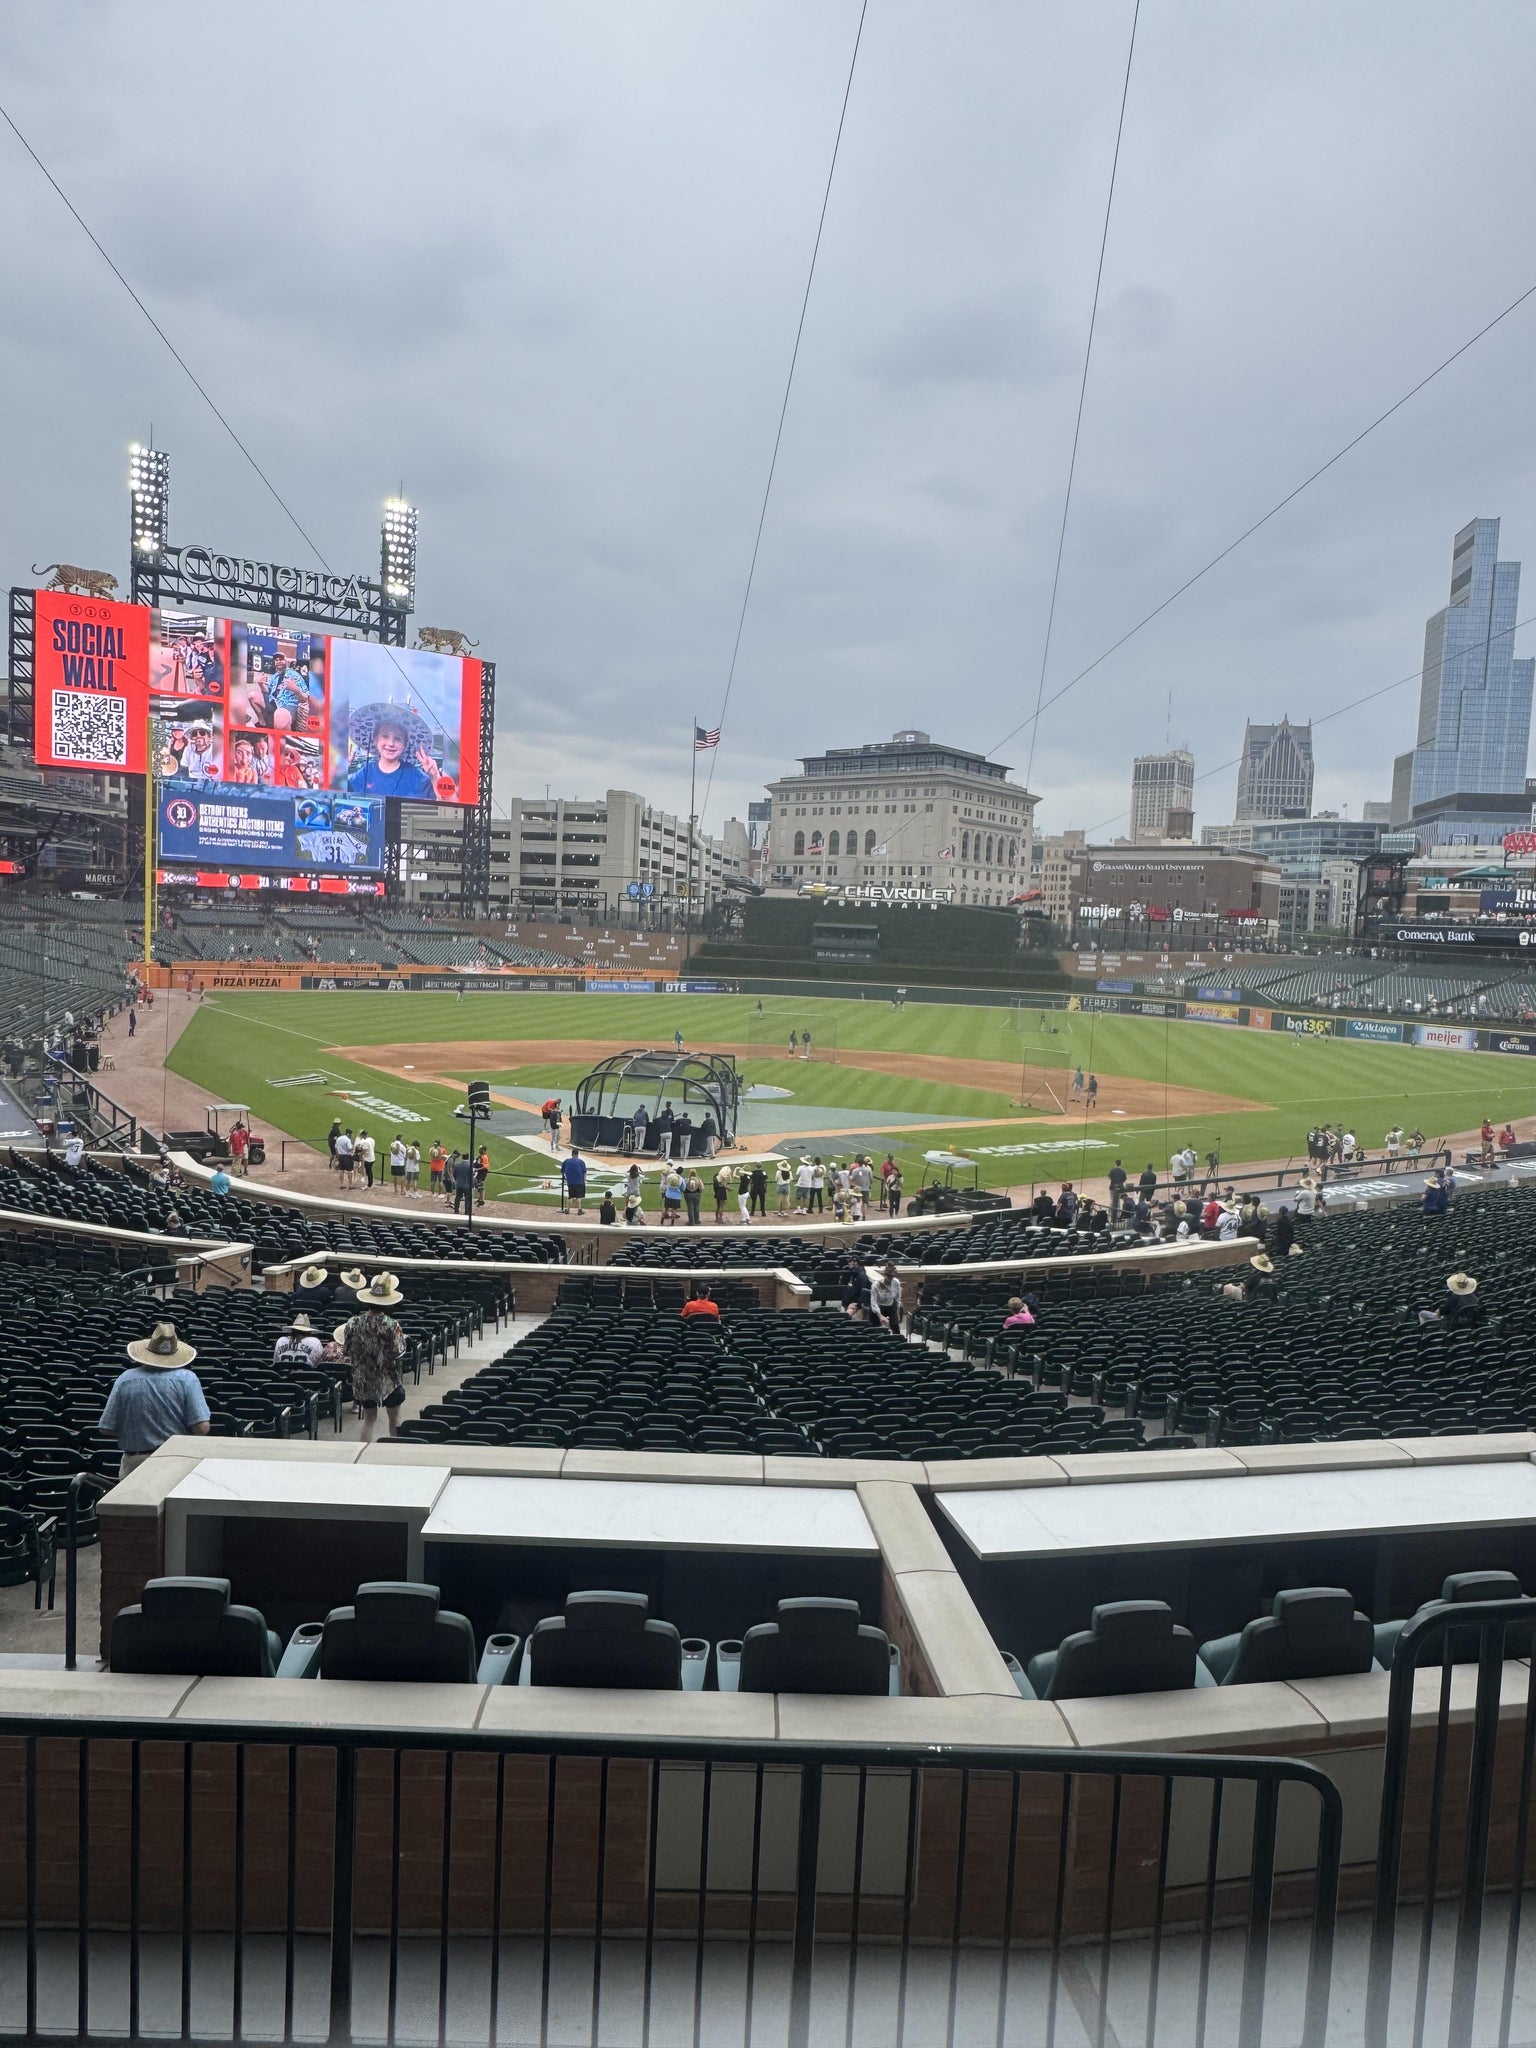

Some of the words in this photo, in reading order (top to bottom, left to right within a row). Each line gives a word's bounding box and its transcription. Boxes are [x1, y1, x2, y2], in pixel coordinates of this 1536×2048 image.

[52, 618, 127, 661] SOCIAL
[62, 654, 118, 692] WALL
[86, 874, 116, 884] MARKET
[845, 886, 956, 902] CHEVROLET
[823, 900, 938, 910] FOUNTAIN
[1080, 903, 1122, 920] meijer
[1238, 917, 1259, 926] LAW
[1447, 931, 1476, 942] Bank
[1223, 954, 1233, 962] 42
[213, 977, 247, 988] PIZZA!
[249, 978, 281, 988] PIZZA!
[665, 983, 688, 992] DTE
[1083, 997, 1118, 1008] FERRIS
[1363, 1022, 1397, 1034] McLaren
[1426, 1030, 1463, 1048] meijer
[1499, 1040, 1530, 1052] Corona
